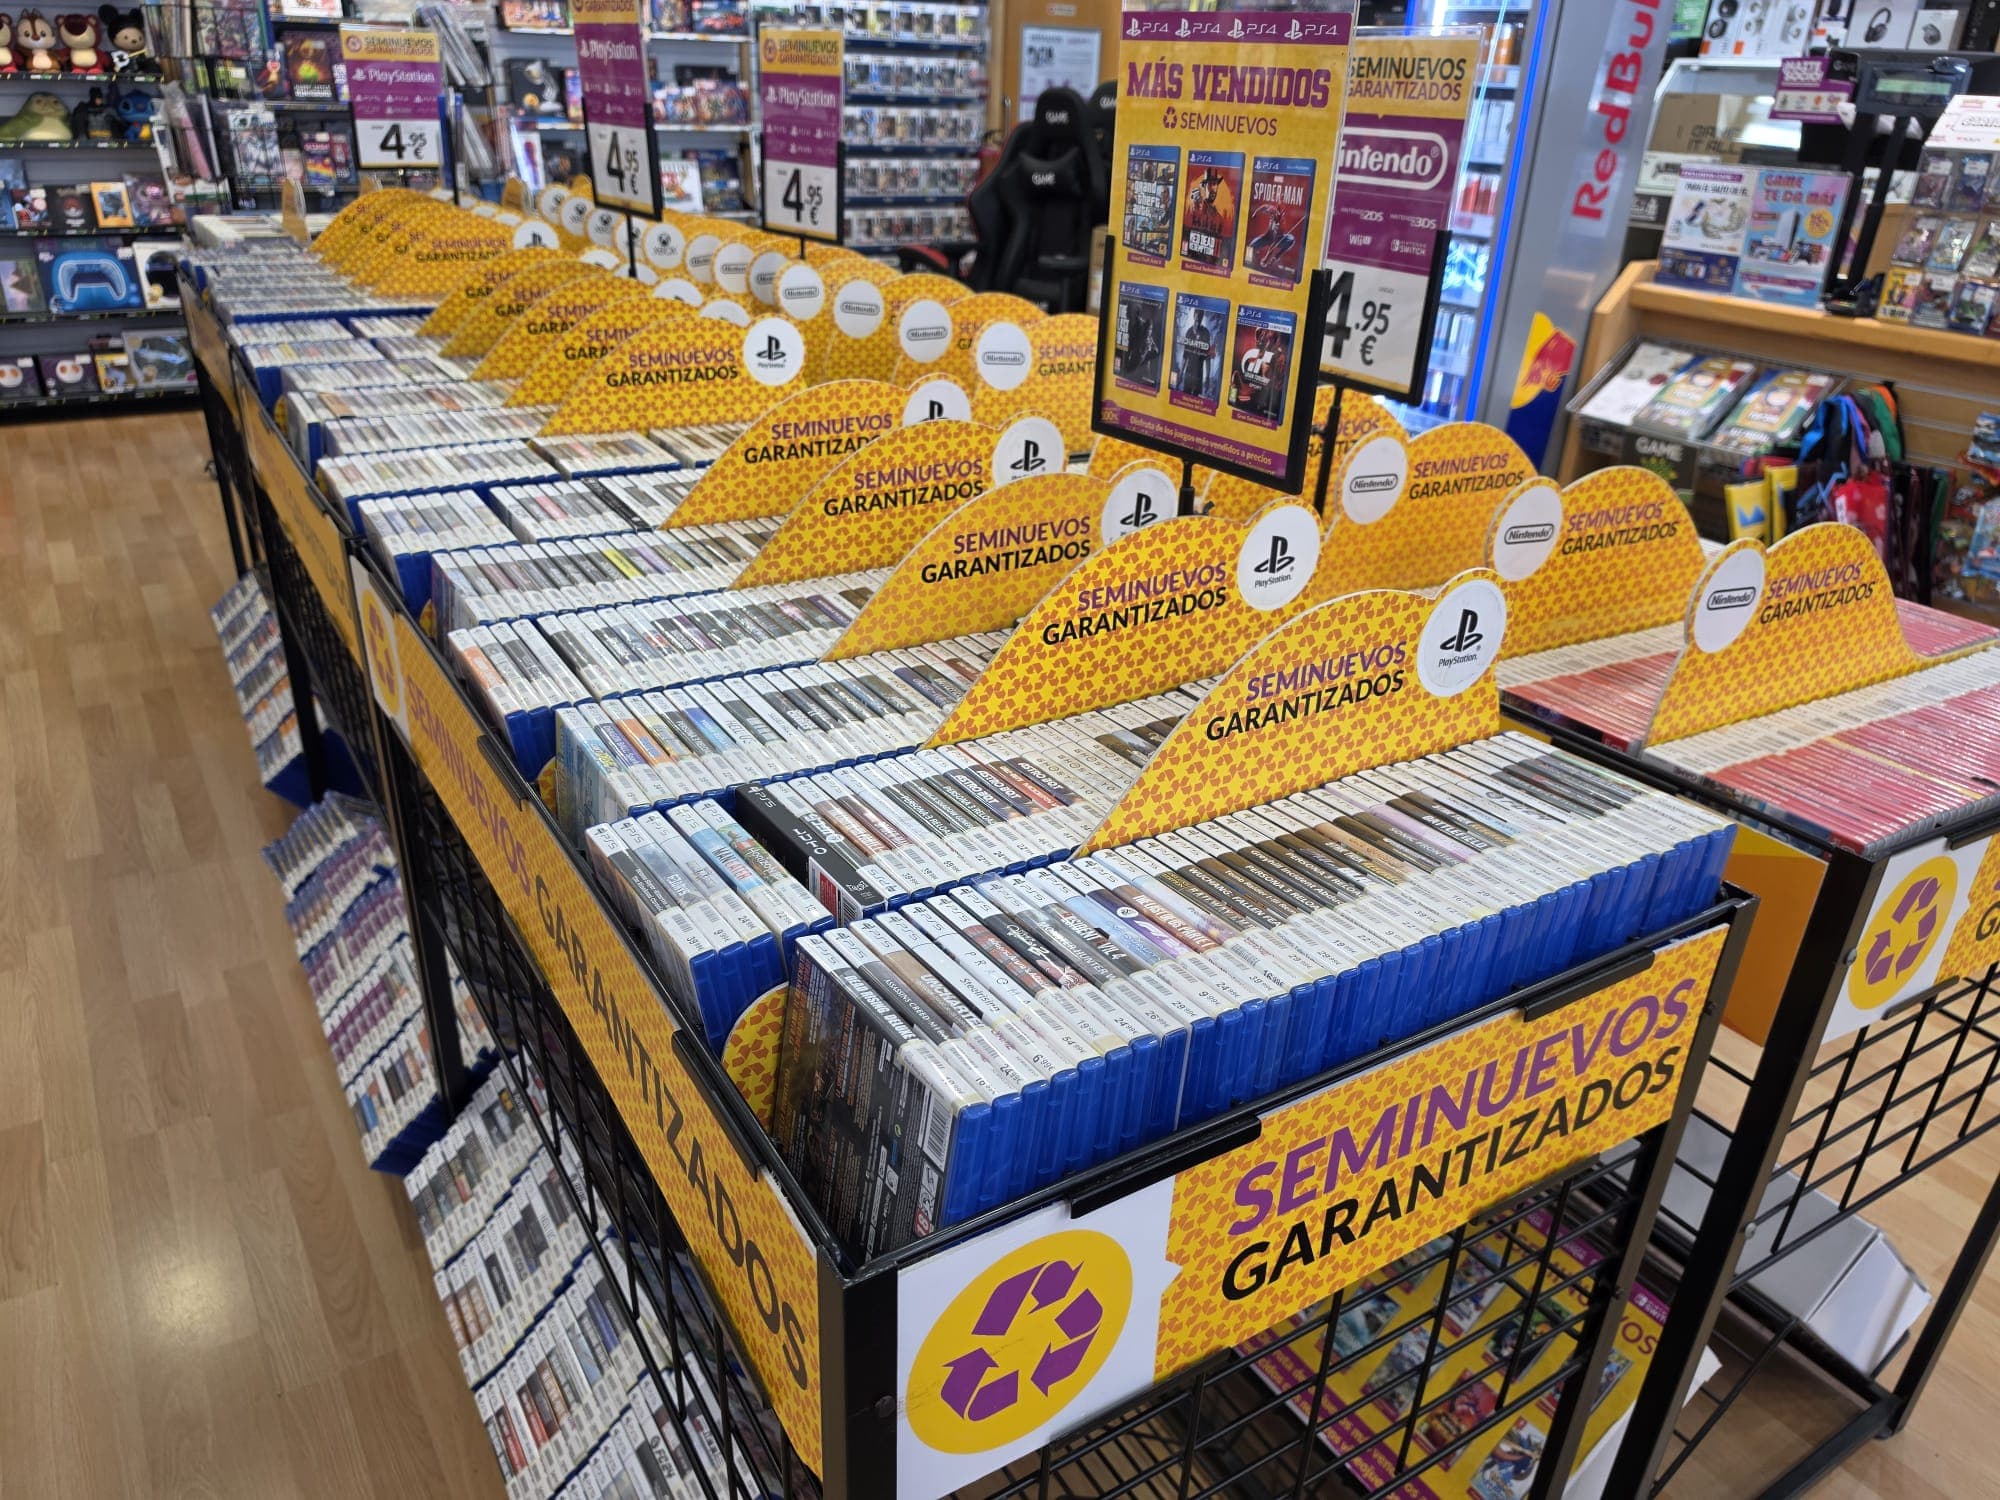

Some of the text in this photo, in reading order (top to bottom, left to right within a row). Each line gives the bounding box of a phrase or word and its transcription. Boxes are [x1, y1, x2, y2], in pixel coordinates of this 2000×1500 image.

[1142, 23, 1337, 35] PS4 PS4 PS4 PS4
[589, 39, 638, 65] PlayStation
[368, 68, 435, 85] PlayStation
[1126, 56, 1331, 108] MÁS VENDIDOS
[778, 86, 835, 110] PlayStation
[1180, 112, 1277, 136] SEMINUEVOS
[1338, 140, 1433, 177] intendo
[1571, 102, 1629, 220] Red
[1253, 183, 1304, 206] SPIDER-MAN
[628, 347, 735, 369] SEMINUEVOS
[1360, 335, 1377, 366] €
[606, 365, 739, 388] GARANTIZADOS
[771, 413, 892, 441] SEMINUEVOS
[1130, 416, 1155, 431] Disfruta
[1156, 423, 1163, 432] de
[1164, 425, 1173, 436] los
[1174, 427, 1194, 442] juegos
[1195, 434, 1209, 446] más
[1209, 439, 1239, 455] vendidos
[1247, 451, 1272, 465] precios
[1635, 436, 1684, 463] GAME
[853, 459, 983, 490] SEMINUEVOS
[1413, 453, 1509, 479] SEMINUEVOS
[1354, 476, 1394, 490] Nintendo
[1409, 471, 1524, 500] GARANTIZADOS
[823, 480, 984, 516] GARANTIZADOS
[1568, 502, 1664, 531] SEMINUEVOS
[953, 516, 1090, 554] SEMINUEVOS
[1508, 527, 1551, 541] Nintendo
[1562, 520, 1678, 556] GARANTIZADOS
[921, 540, 1090, 584] GARANTIZADOS
[1077, 562, 1226, 612] SEMINUEVOS
[1255, 574, 1293, 588] PlayStation
[1767, 562, 1863, 600] SEMINUEVOS
[1710, 590, 1752, 606] Nintendo
[1760, 581, 1875, 625] GARANTIZADOS
[1042, 587, 1226, 645] GARANTIZADOS
[1246, 641, 1406, 701] SEMINUEVOS
[1438, 653, 1478, 668] PlayStation
[1206, 669, 1404, 741] GARANTIZADOS
[954, 773, 980, 791] ASTRO
[976, 768, 1003, 786] ASTRO
[1017, 760, 1045, 779] ASTRO
[707, 806, 726, 824] PS5
[1422, 813, 1488, 850] BATTLEFIELD
[680, 811, 752, 882] PS5 MANEATER
[1068, 869, 1091, 887] PS5
[1094, 866, 1117, 884] PS5
[1244, 863, 1286, 890] PERSONA
[1021, 883, 1045, 902] PS5
[921, 911, 945, 931] PS5
[897, 921, 1001, 1013] PS5 Steelrising
[1073, 947, 1110, 976] HUNTER
[815, 943, 837, 963] PS5
[844, 973, 870, 994] DEAD
[882, 1011, 917, 1040] DELUXE
[843, 938, 866, 959] PS5
[908, 1001, 932, 1021] CREED
[870, 927, 983, 1028] PS5 UNCHARTE
[407, 676, 809, 1392] SEMINUEVOS GARANTIZADOS
[1228, 979, 1696, 1236] SEMINUEVOS
[1221, 1046, 1679, 1300] GARANTIZADOS
